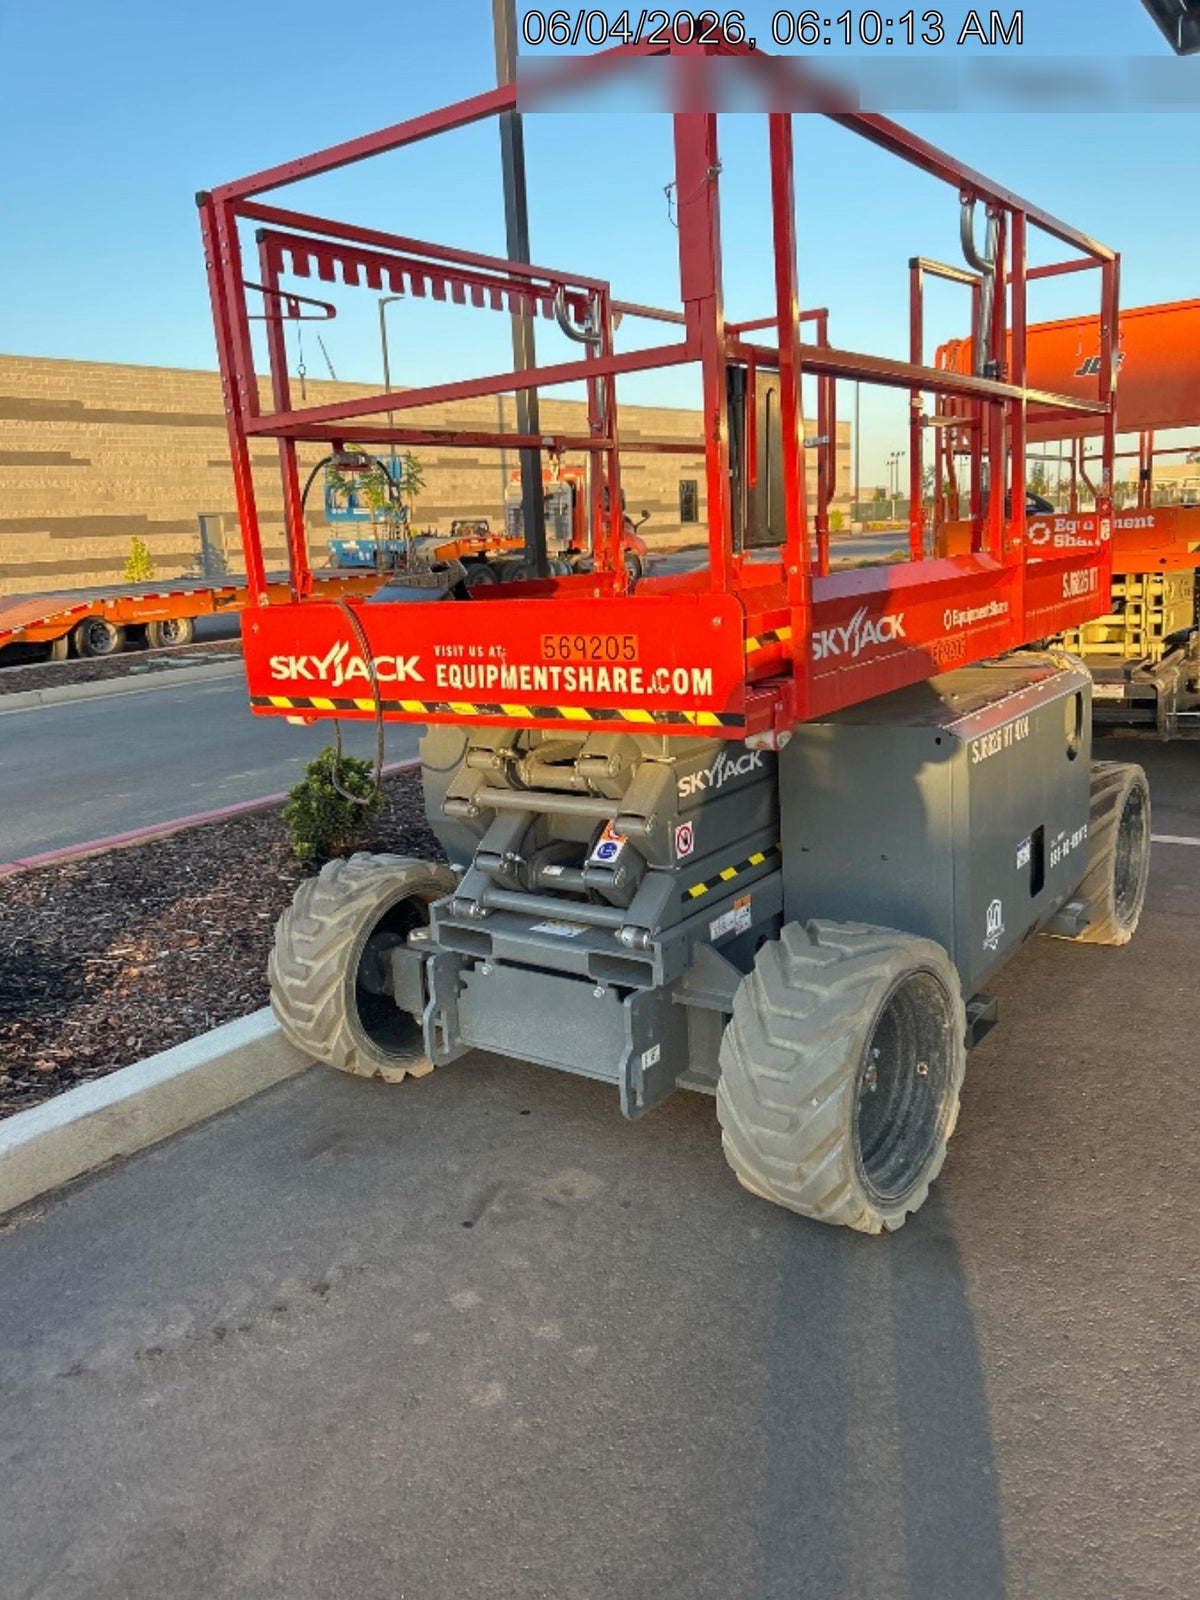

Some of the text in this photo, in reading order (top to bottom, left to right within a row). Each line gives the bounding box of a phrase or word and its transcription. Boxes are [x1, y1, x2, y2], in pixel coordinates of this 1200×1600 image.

[1054, 515, 1155, 534] Eqent
[543, 635, 636, 660] 569205
[812, 606, 906, 660] SKYJACK
[269, 640, 425, 687] SKYJACK
[434, 645, 463, 657] VISIT
[468, 645, 483, 657] US
[436, 664, 713, 696] EQUIPMENTSHARE.COM
[678, 750, 763, 797] SKYJACK
